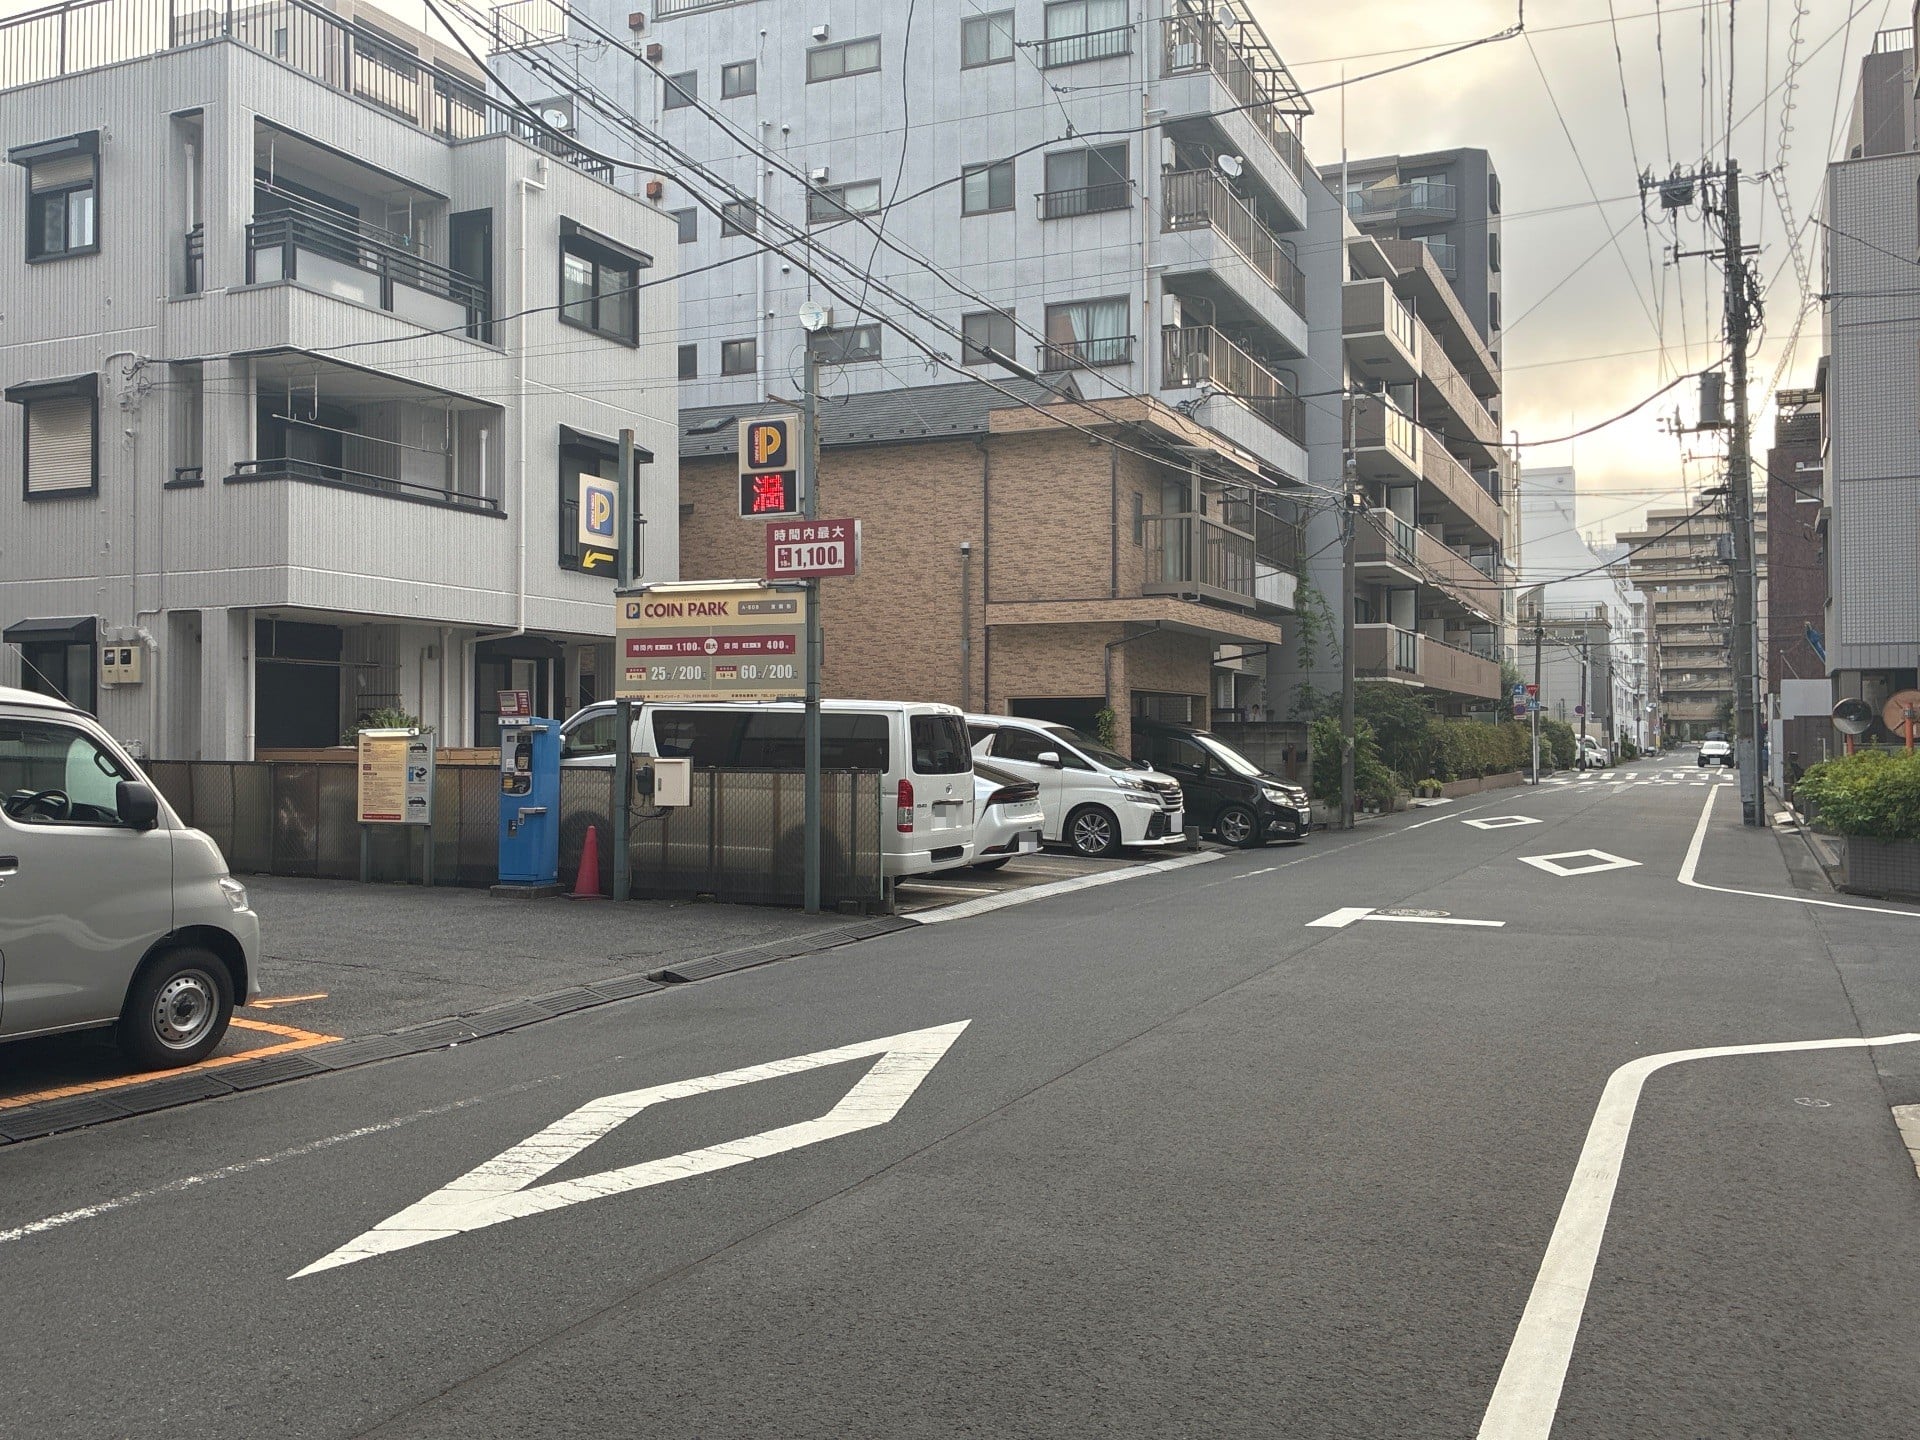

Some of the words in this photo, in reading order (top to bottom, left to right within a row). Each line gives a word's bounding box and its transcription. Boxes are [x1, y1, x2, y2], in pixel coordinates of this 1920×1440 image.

[759, 426, 782, 464] P
[594, 492, 610, 530] P
[753, 473, 785, 512] 満
[774, 526, 845, 542] 時間内最大
[644, 602, 683, 618] COIN
[687, 600, 729, 617] PARK
